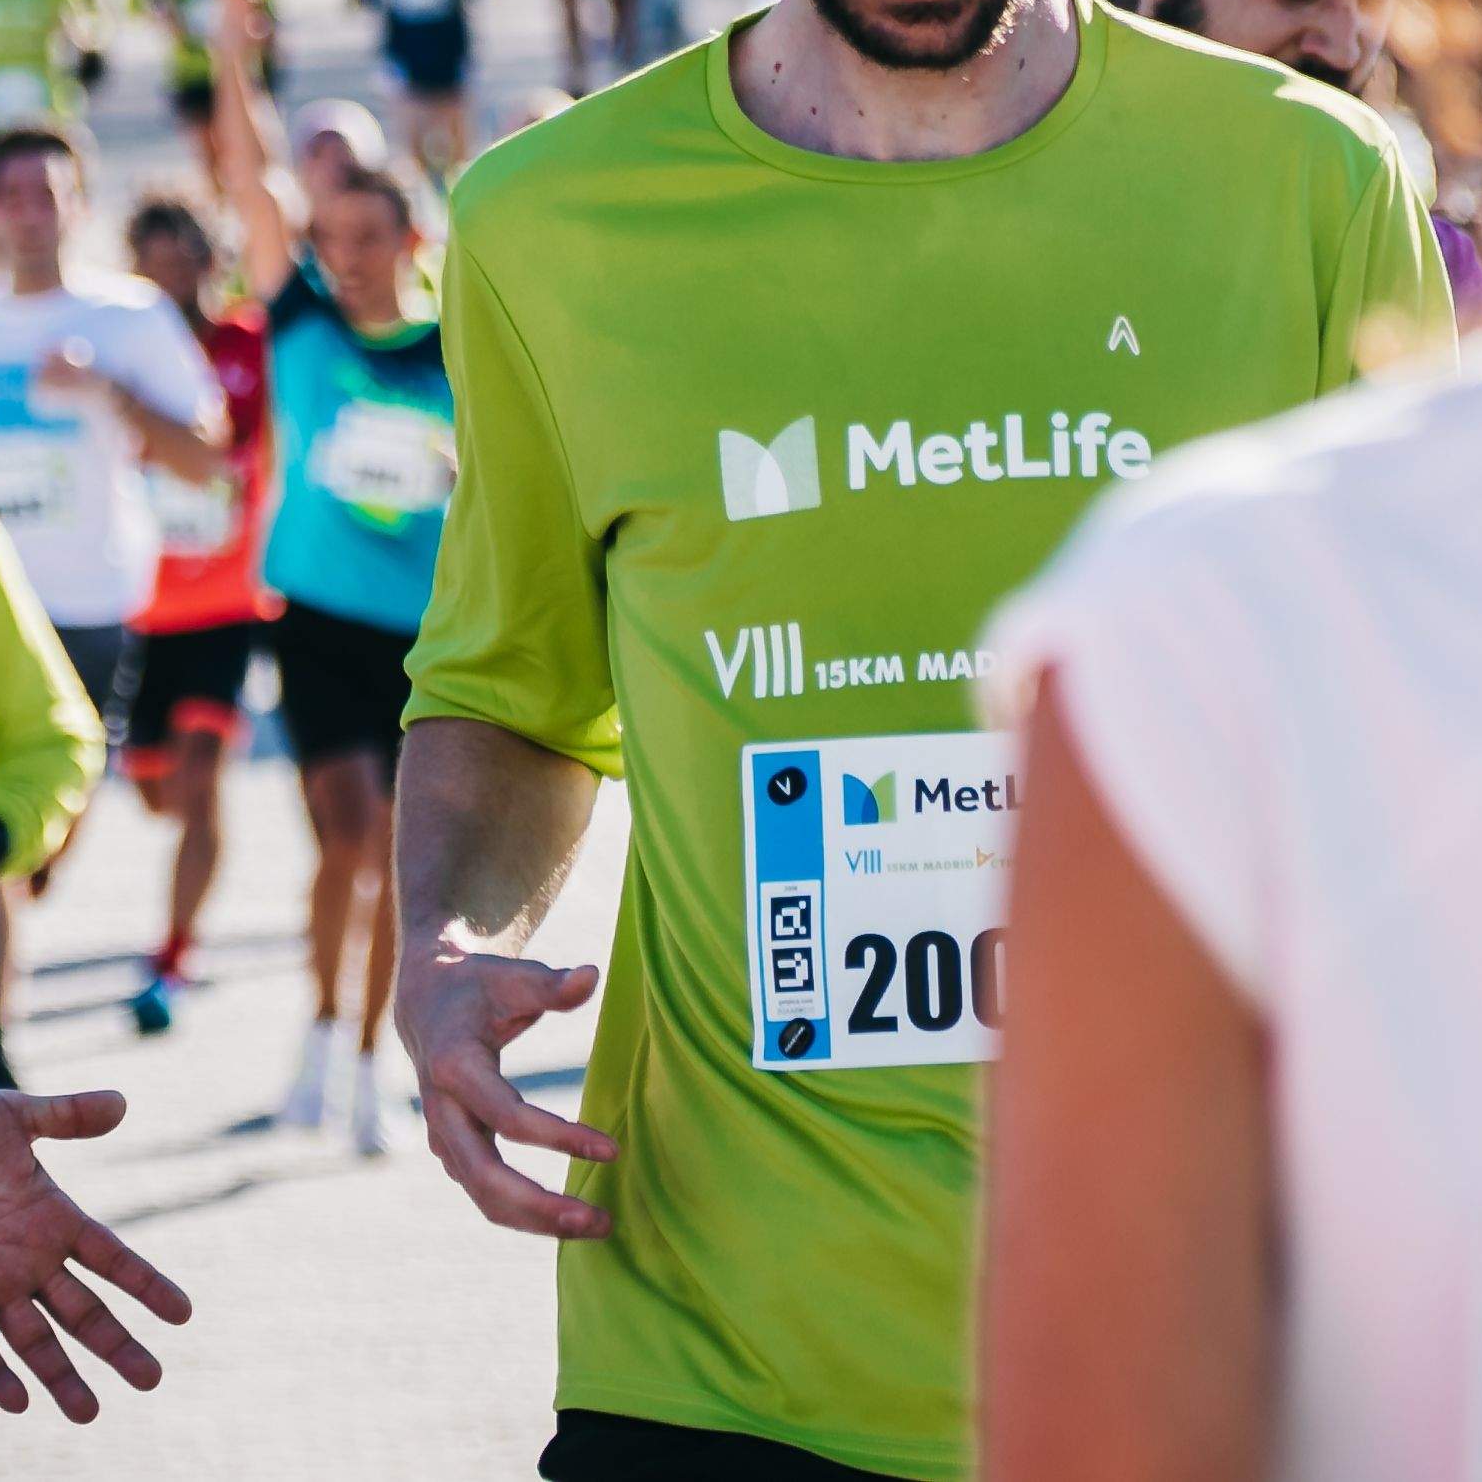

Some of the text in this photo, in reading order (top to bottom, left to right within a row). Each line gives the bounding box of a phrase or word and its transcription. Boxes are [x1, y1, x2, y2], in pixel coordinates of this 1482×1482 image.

[847, 411, 1153, 491] MetLife
[704, 621, 805, 700] VIII
[814, 654, 905, 691] 15KM
[844, 848, 882, 874] VIII
